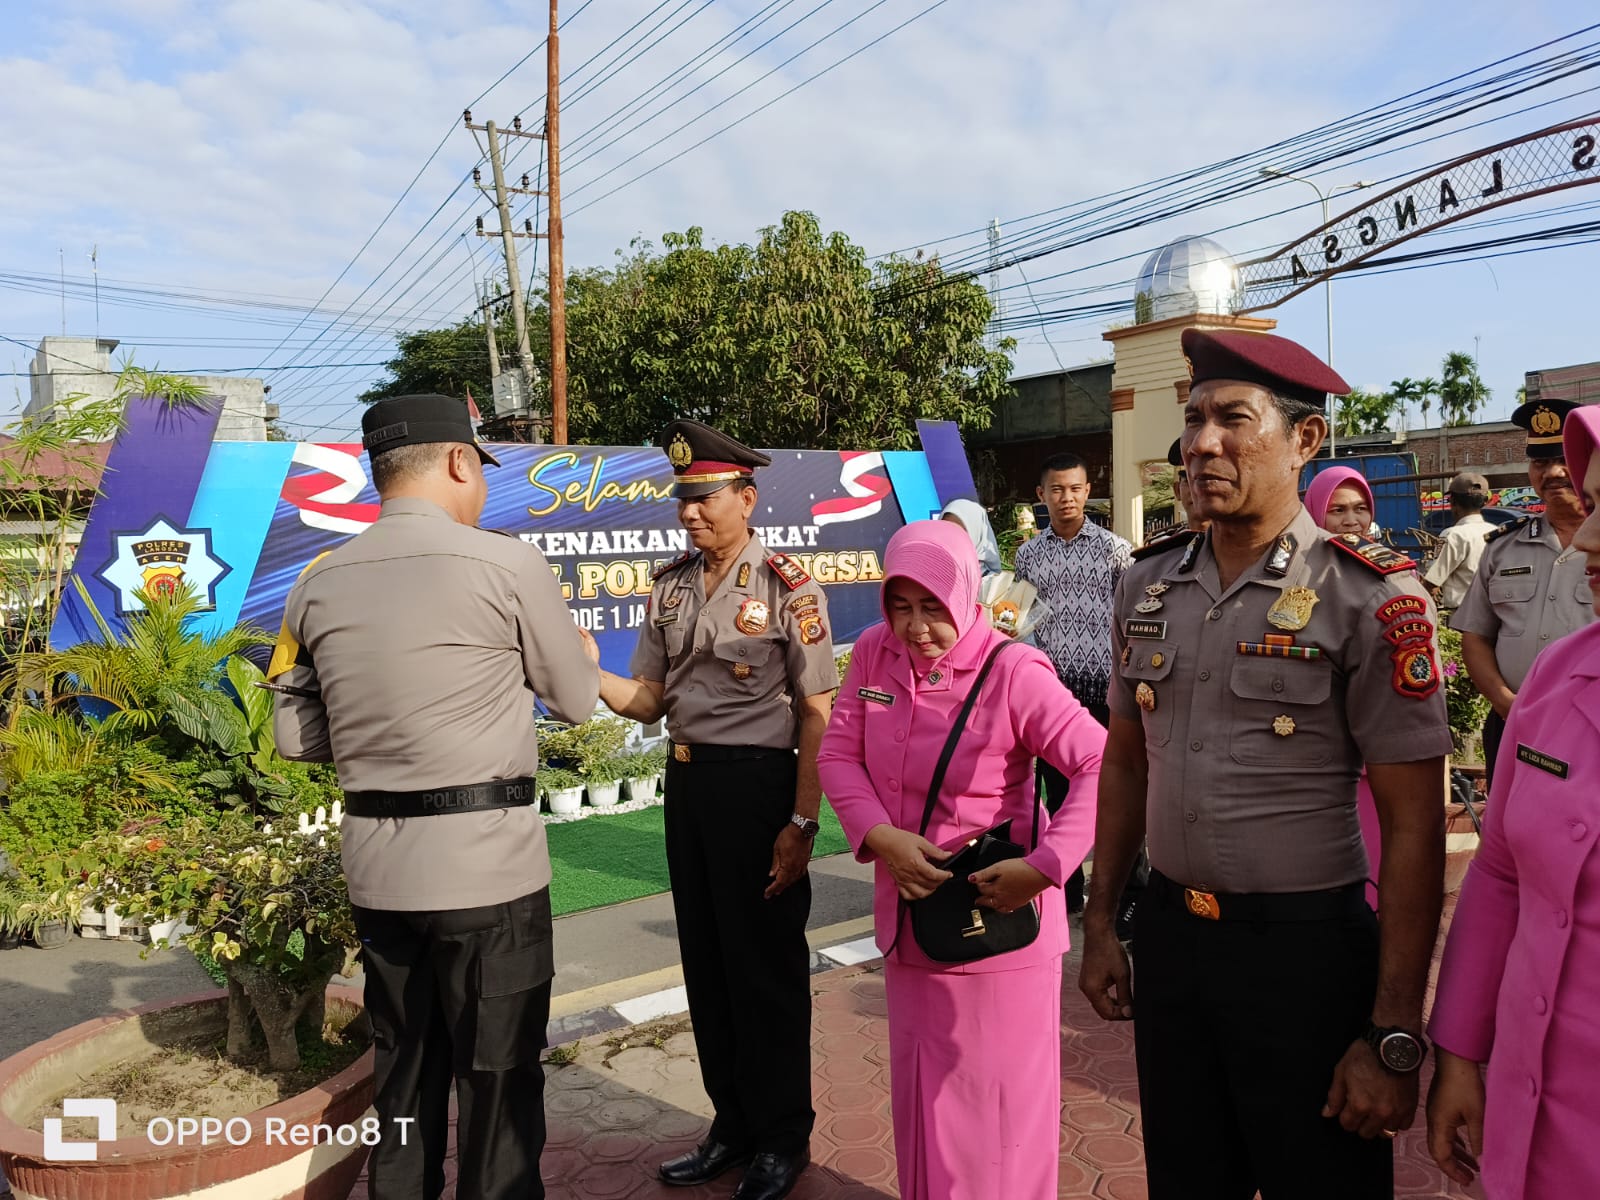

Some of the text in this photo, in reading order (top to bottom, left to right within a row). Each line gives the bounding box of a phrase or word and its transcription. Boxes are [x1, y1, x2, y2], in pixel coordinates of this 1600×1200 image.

[138, 541, 184, 550] POLRES
[578, 560, 655, 600] POL
[1385, 599, 1420, 616] POLDA
[611, 605, 620, 629] 1
[1394, 623, 1427, 638] ACEH
